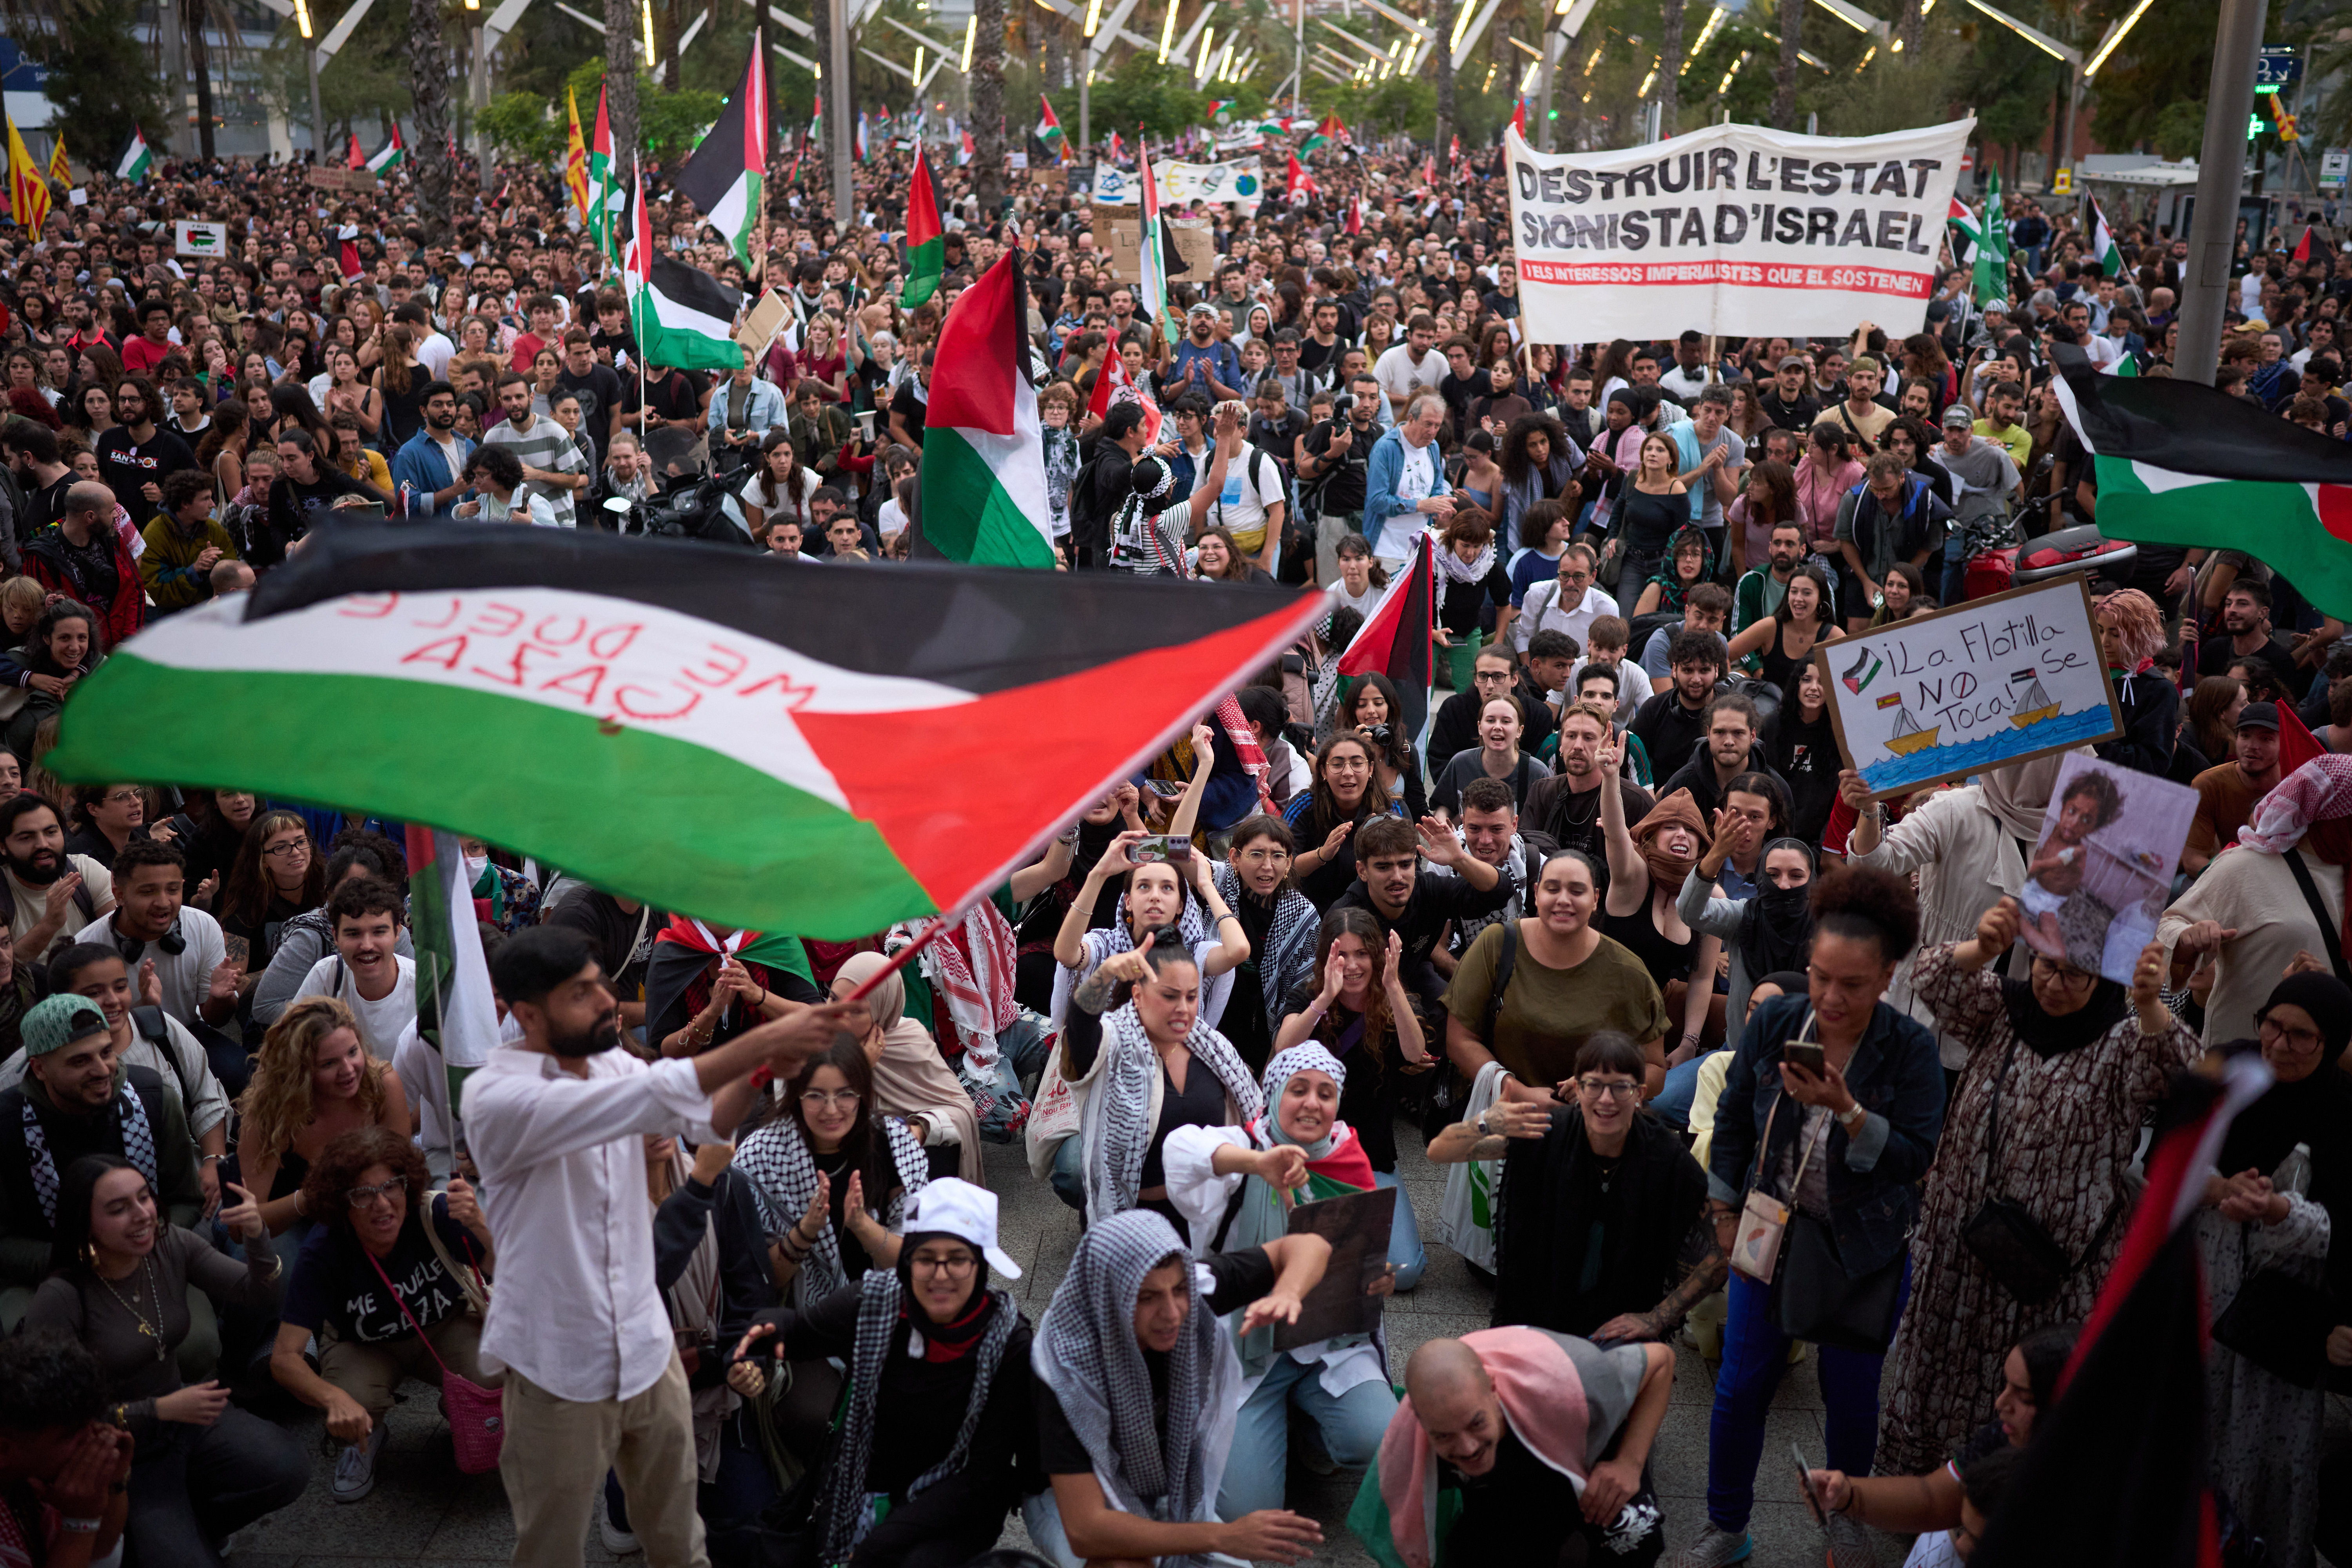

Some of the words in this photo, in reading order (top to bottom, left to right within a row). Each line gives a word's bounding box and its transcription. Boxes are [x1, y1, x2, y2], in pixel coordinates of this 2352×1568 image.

[1516, 147, 1738, 204] DESTRUIR
[1746, 151, 1942, 199] L'ESTAT
[1521, 206, 1707, 251] SIONISTA
[1713, 202, 1930, 255] D'ISRAEL
[1532, 264, 1553, 279] ELS
[1554, 265, 1642, 282] INTERESSOS
[1647, 264, 1762, 282] IMPERIALISTES
[1767, 267, 1802, 284] QUE
[1807, 269, 1828, 285] EL
[1832, 270, 1923, 293] SOSTENEN
[1960, 615, 2065, 663] Flotilla
[1918, 671, 1977, 711] NO
[2042, 648, 2089, 674] Se
[1935, 683, 2017, 733] Toca!
[1042, 1106, 1058, 1117] Nou
[1060, 1102, 1072, 1111] Bar
[346, 1292, 377, 1316] ME
[355, 1287, 452, 1342] GAZA
